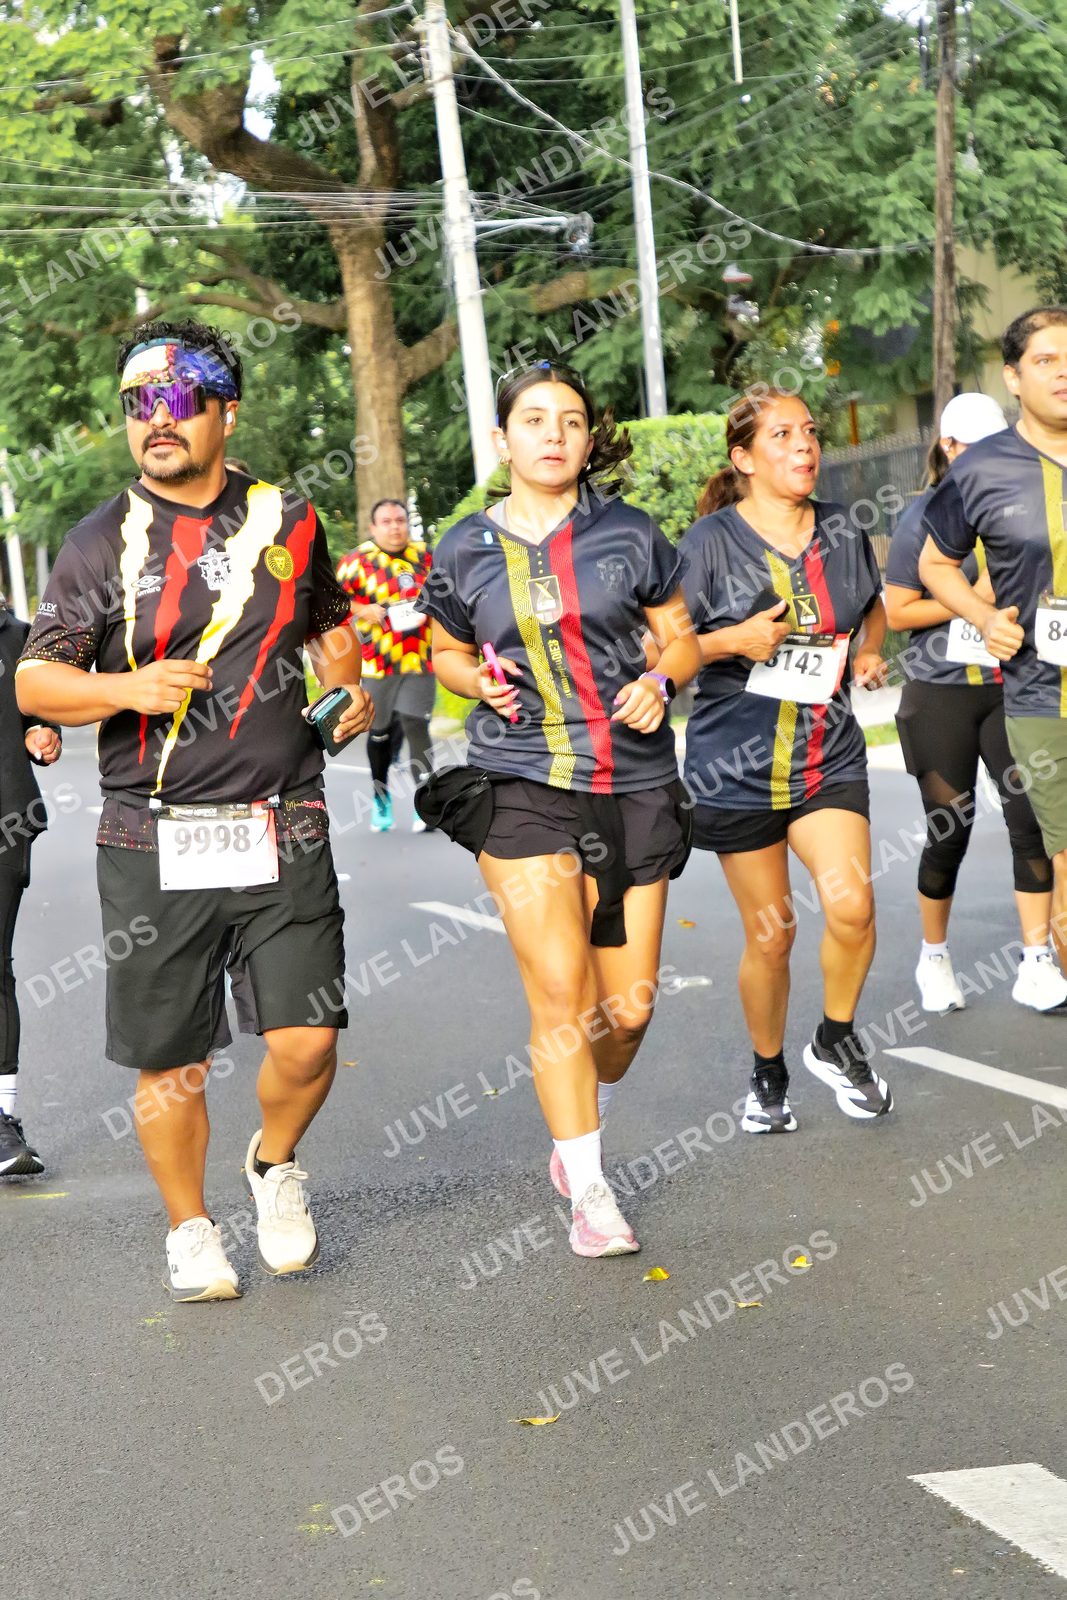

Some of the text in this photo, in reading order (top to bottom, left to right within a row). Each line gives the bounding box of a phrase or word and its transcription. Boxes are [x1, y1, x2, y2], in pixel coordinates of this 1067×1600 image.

[137, 586, 162, 597] umbro
[1047, 620, 1067, 641] 8
[174, 824, 251, 856] 9998
